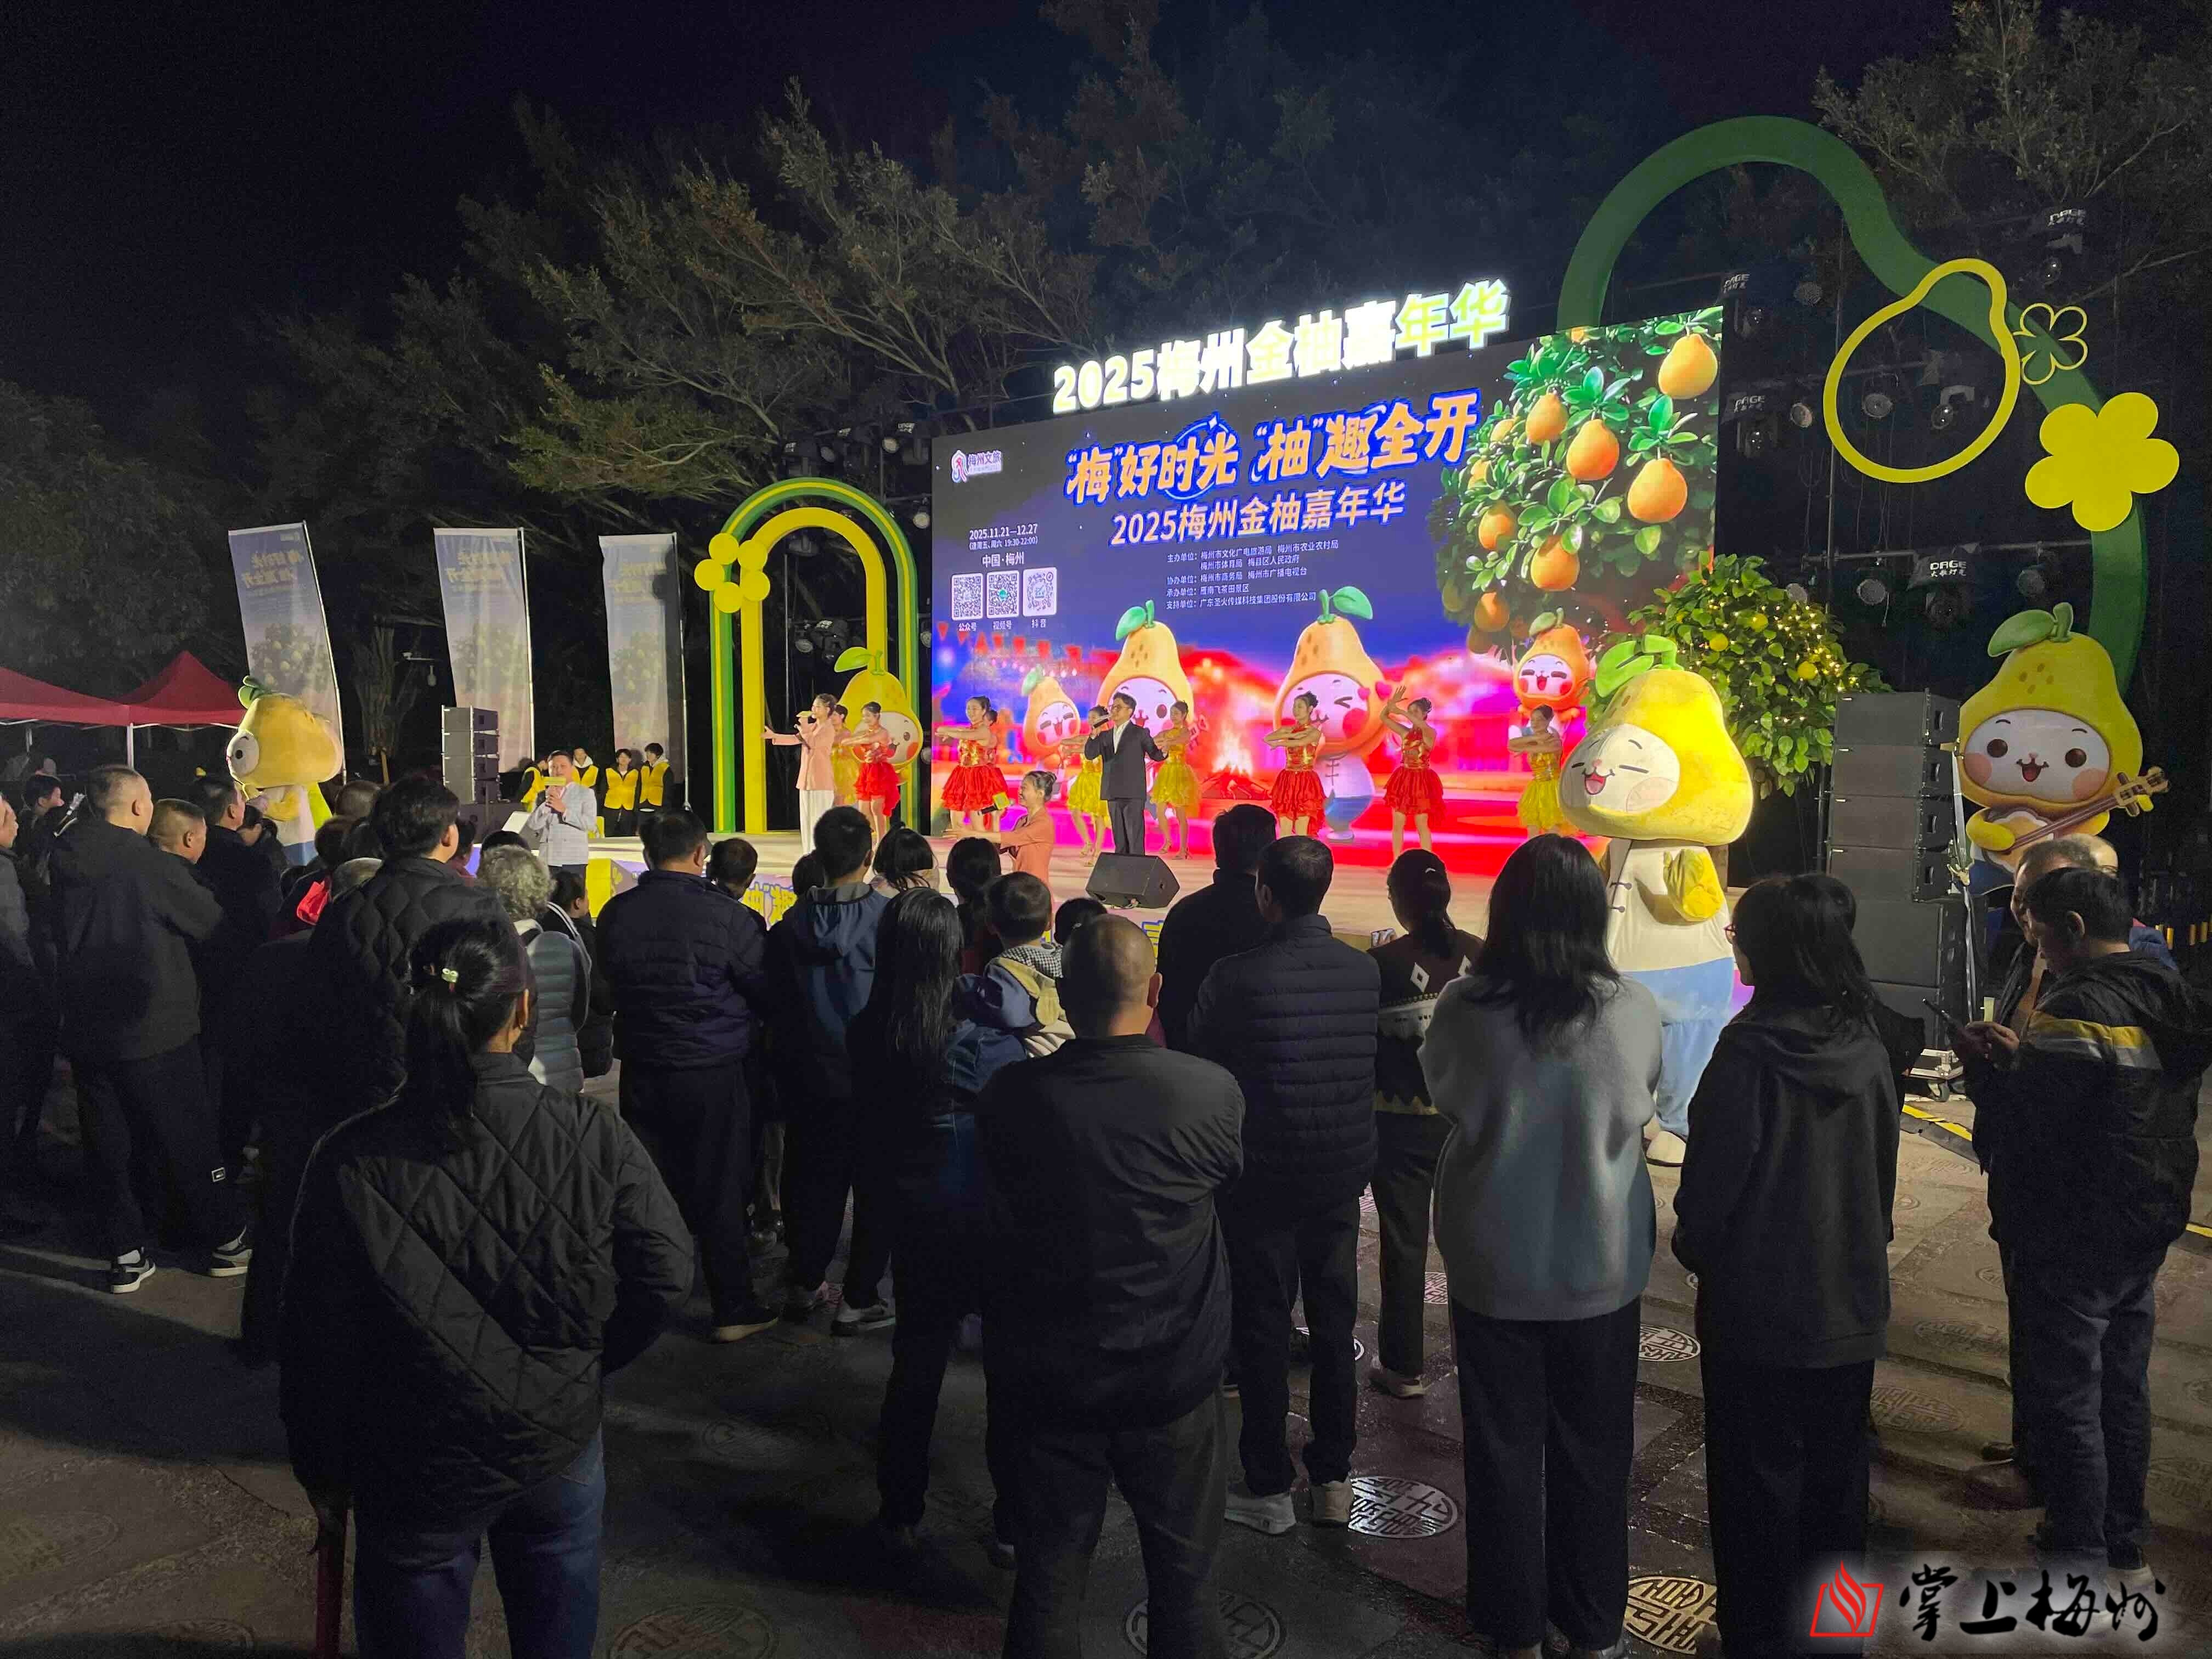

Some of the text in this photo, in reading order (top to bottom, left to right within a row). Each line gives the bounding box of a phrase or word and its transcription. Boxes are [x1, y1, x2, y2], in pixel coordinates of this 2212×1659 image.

[1052, 279, 1510, 415] 2025梅州金柚嘉年华
[1110, 479, 1406, 545] 2025梅州金柚嘉年华
[982, 551, 1025, 568] 中国·梅州
[1930, 560, 1966, 570] DAGE
[958, 622, 977, 631] 公众号
[1031, 618, 1047, 629] 抖音
